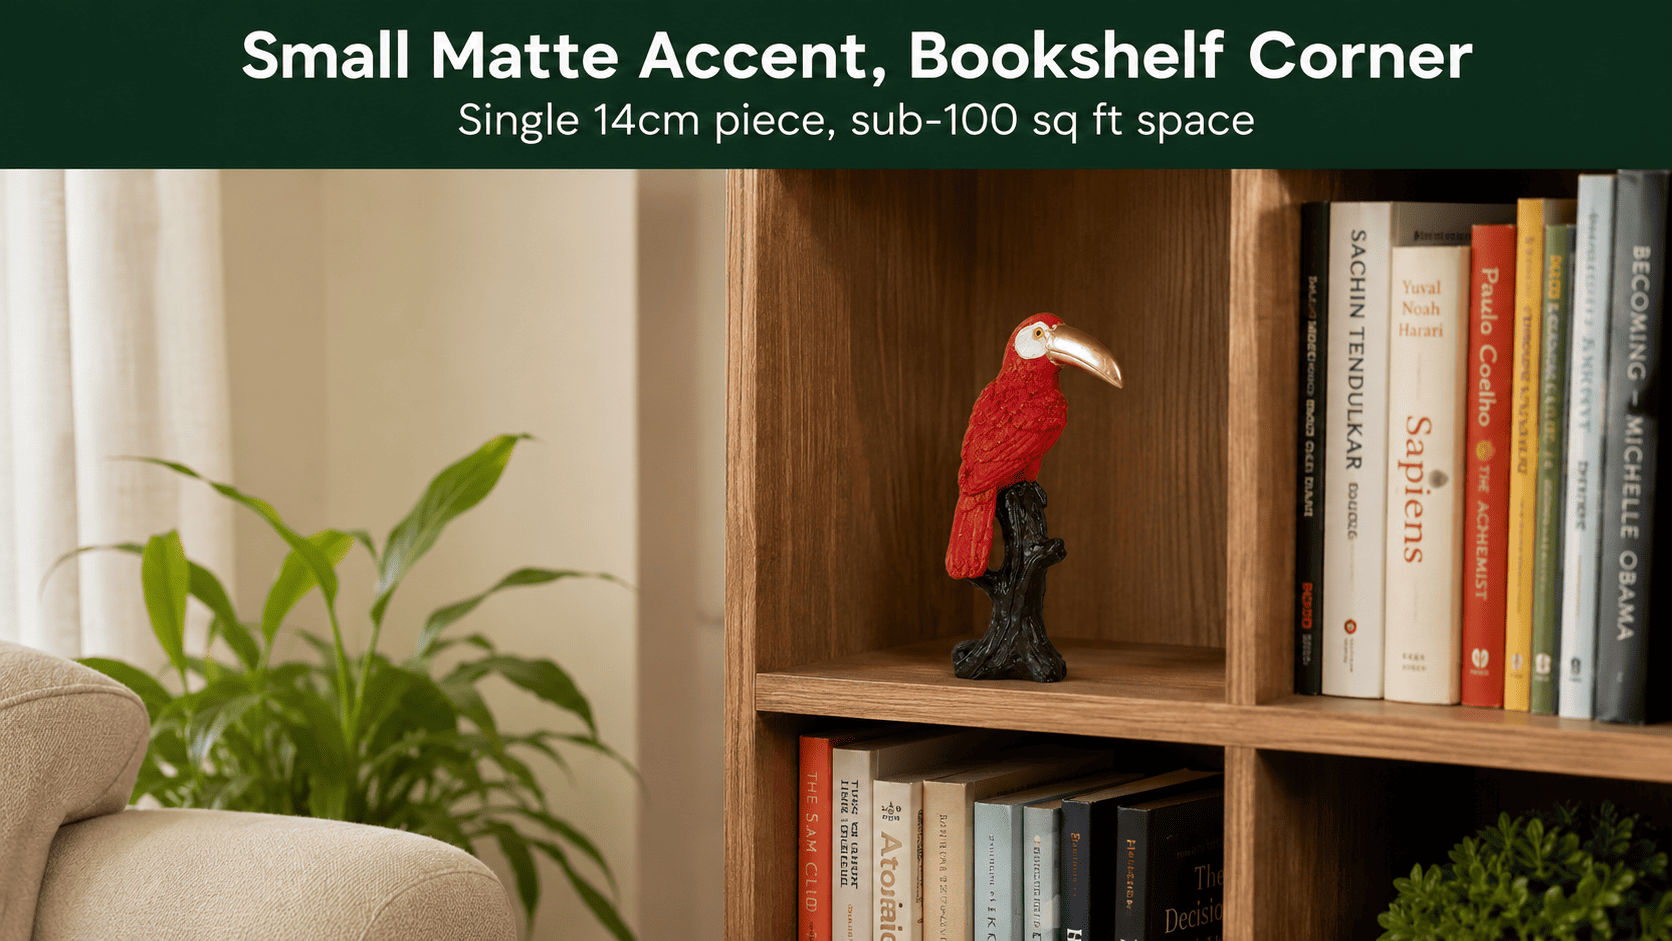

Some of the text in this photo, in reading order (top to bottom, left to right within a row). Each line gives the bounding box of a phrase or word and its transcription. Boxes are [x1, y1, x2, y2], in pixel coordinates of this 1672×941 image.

[1349, 229, 1367, 319] SACHIN
[1402, 280, 1441, 295] Yuval
[1402, 302, 1441, 316] Noah
[1627, 245, 1651, 381] BECOMING
[1399, 323, 1443, 338] Harari
[1478, 267, 1499, 427] Paulo Coelho
[1346, 327, 1365, 470] TENDULKAR
[1397, 415, 1432, 564] Sapiens
[1620, 414, 1643, 539] MICHELLE
[1616, 550, 1638, 641] OBAMA
[806, 771, 818, 804] THE
[1194, 863, 1223, 891] The
